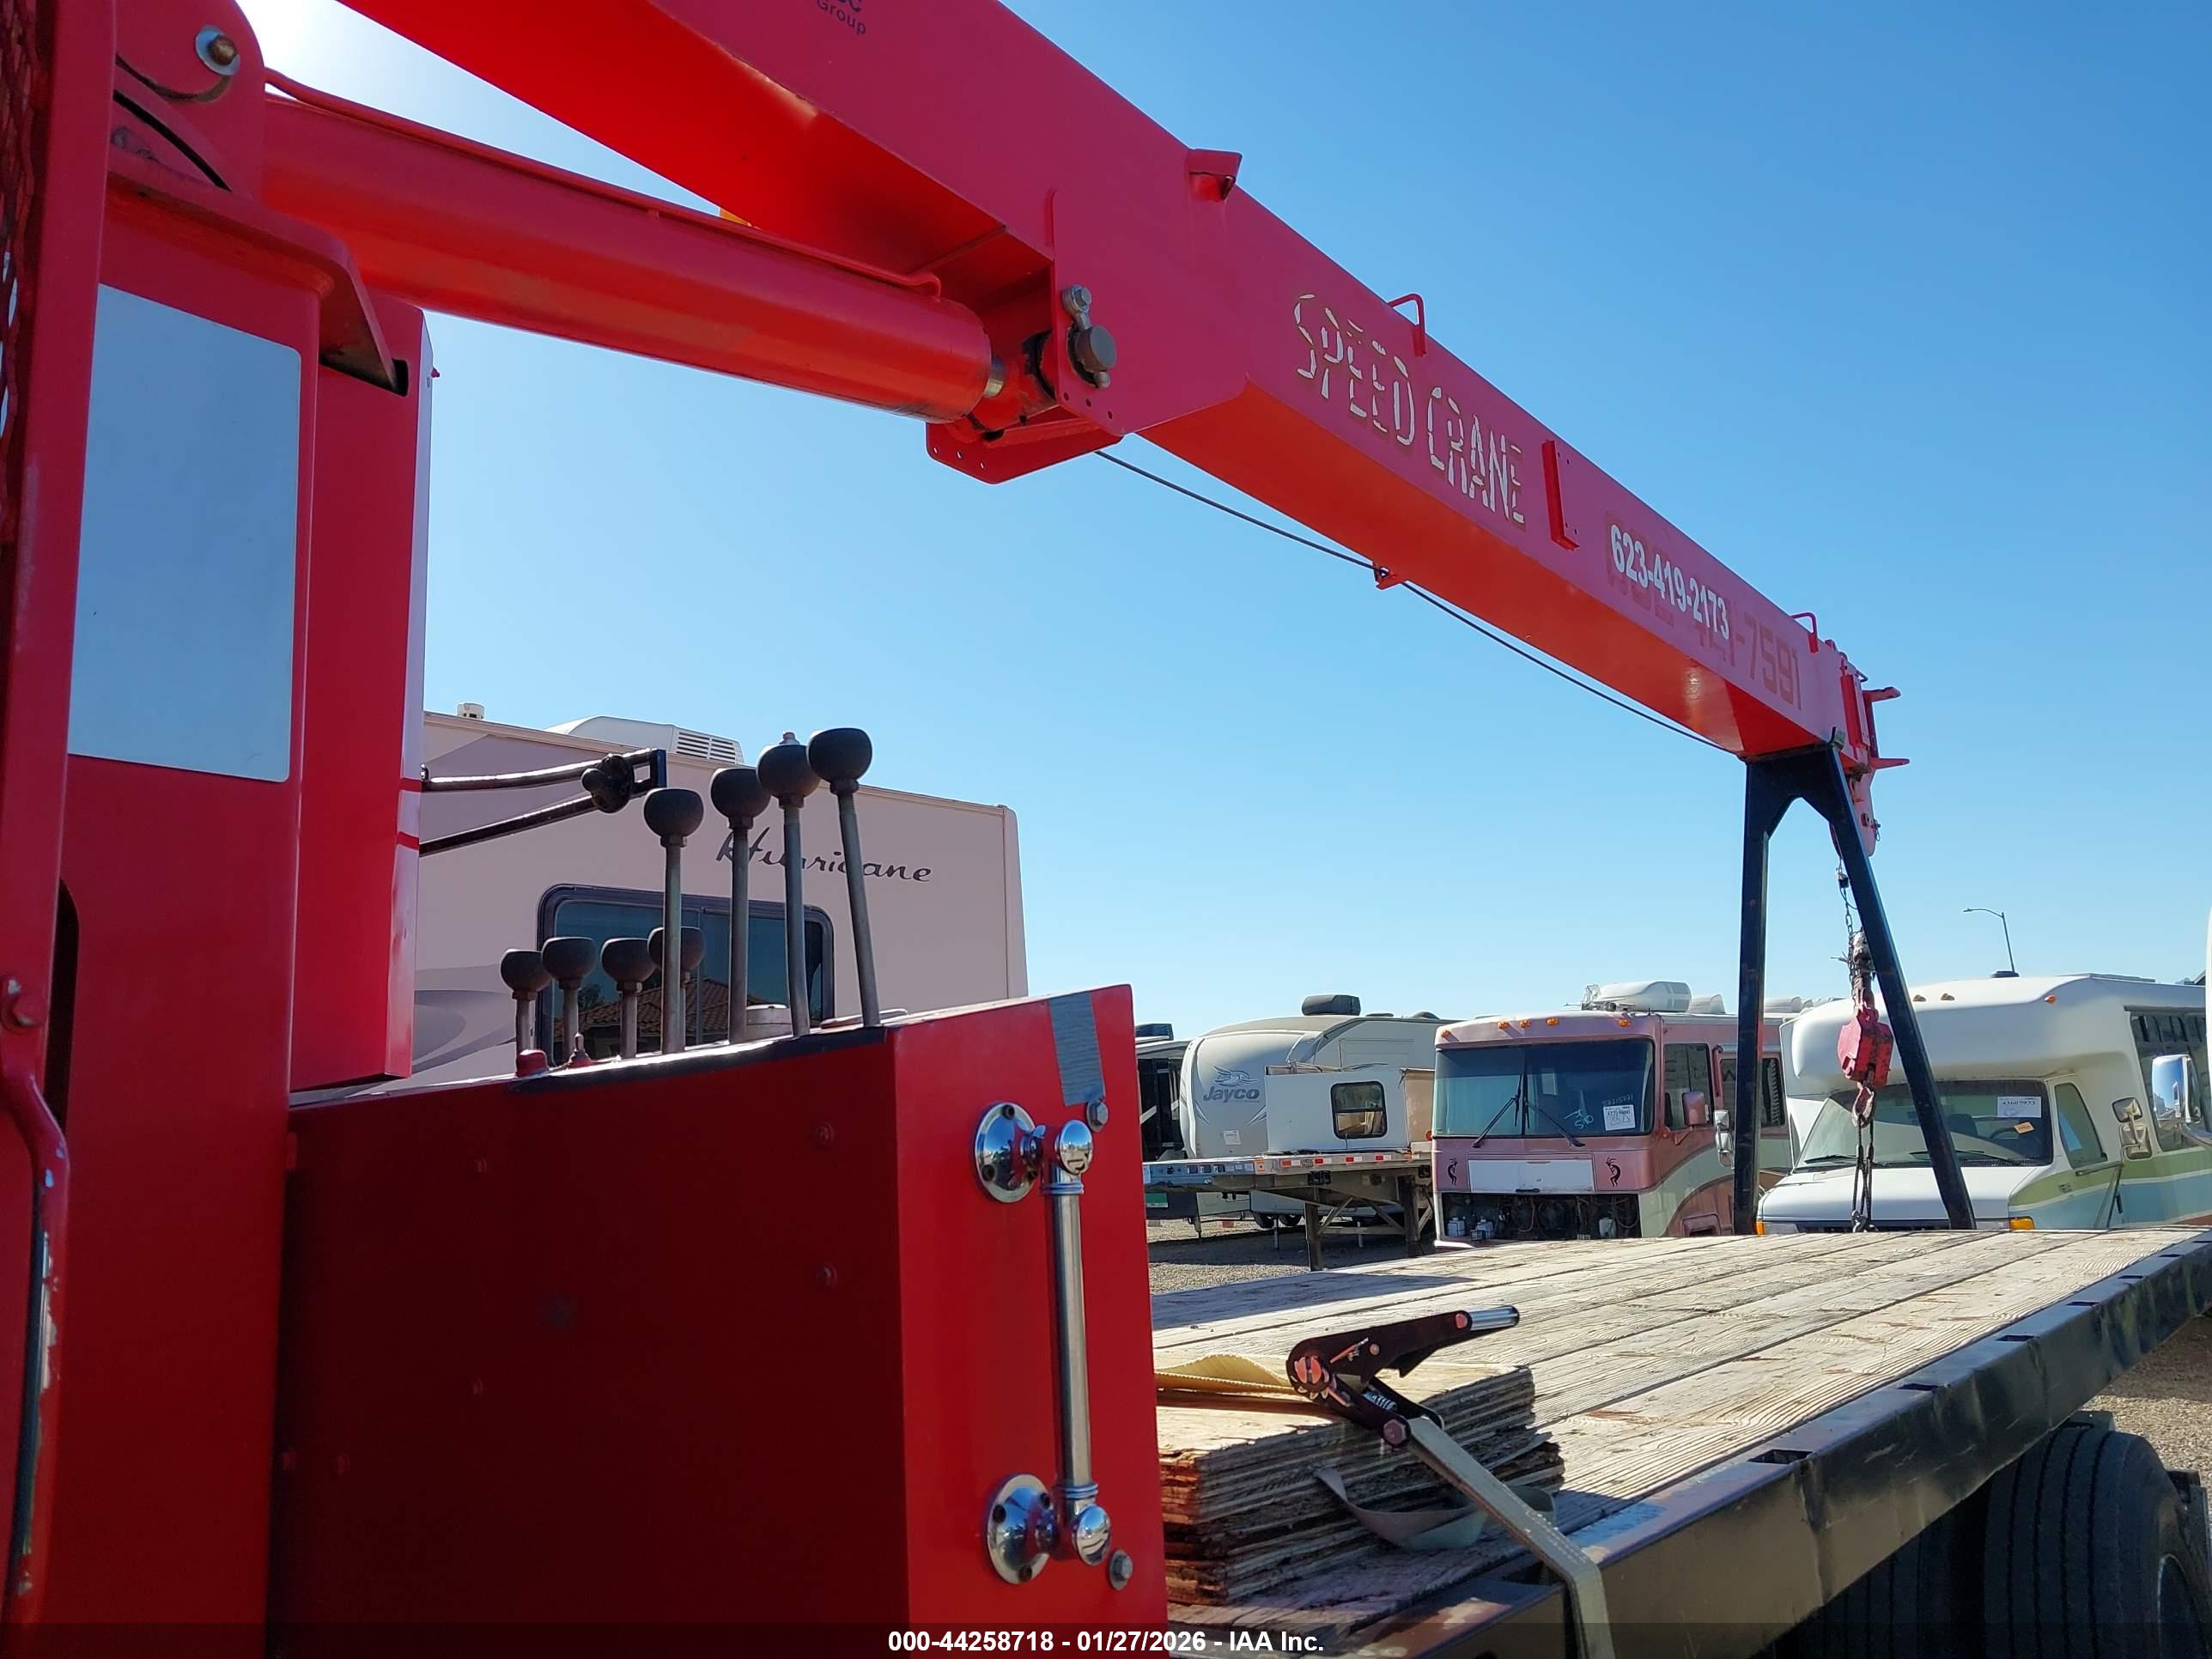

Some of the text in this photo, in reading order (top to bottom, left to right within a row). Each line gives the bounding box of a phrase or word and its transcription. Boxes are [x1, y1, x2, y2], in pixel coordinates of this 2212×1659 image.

[817, 0, 866, 35] Group
[1293, 293, 1525, 525] SPEED CRANE
[1610, 524, 1730, 640] 623-419-2173
[1202, 1085, 1261, 1103] Jayco
